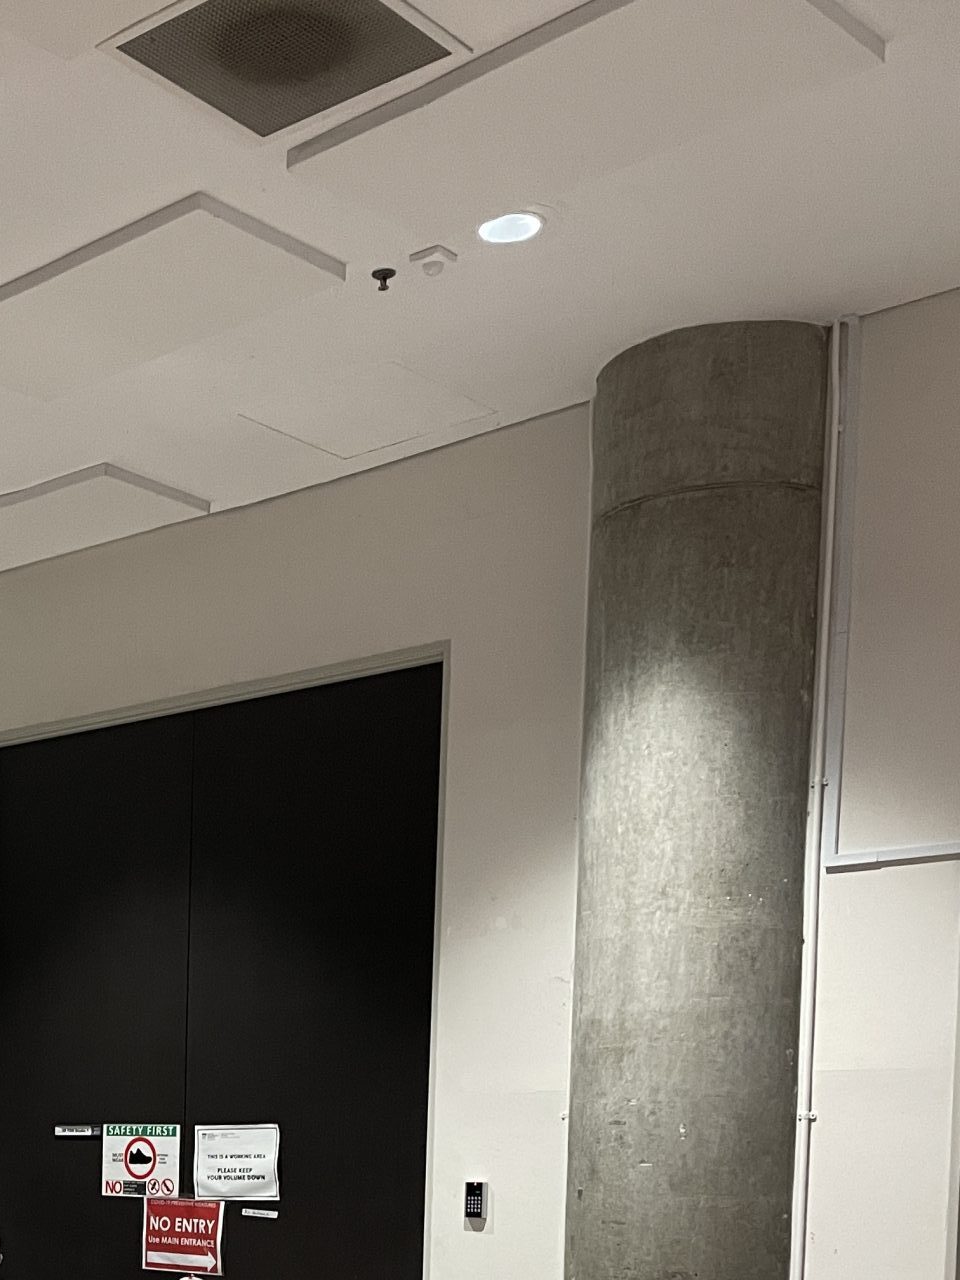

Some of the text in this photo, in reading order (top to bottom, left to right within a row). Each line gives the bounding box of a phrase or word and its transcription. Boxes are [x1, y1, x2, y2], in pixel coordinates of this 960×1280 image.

[108, 1125, 142, 1136] SAFETY
[146, 1126, 174, 1136] FIRST
[105, 1181, 122, 1194] NO
[149, 1216, 215, 1234] NO ENTRY
[148, 1235, 215, 1248] Use MAIN ENTRANCE
